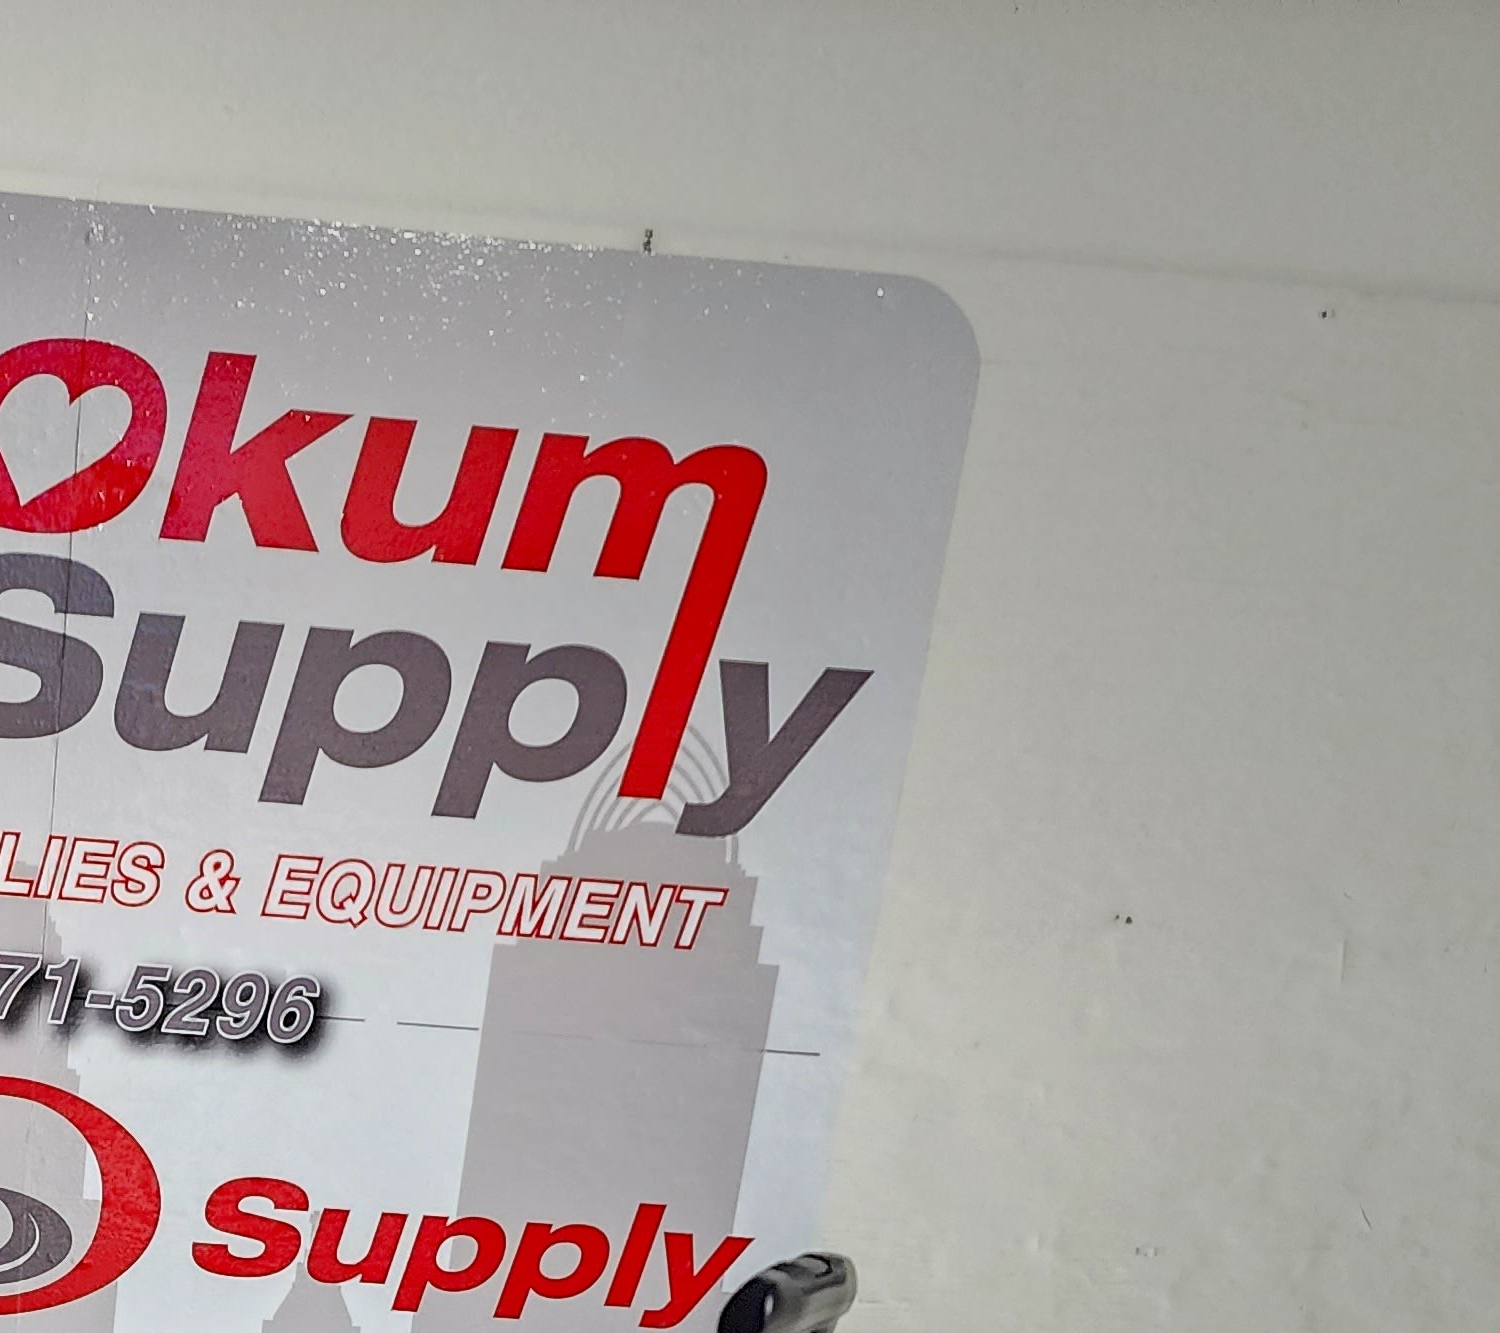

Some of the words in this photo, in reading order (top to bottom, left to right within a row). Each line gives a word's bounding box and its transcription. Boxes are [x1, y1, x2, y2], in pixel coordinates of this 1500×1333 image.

[184, 849, 242, 914] &
[260, 853, 729, 951] EQUIPMENT
[191, 1176, 754, 1329] Supply
